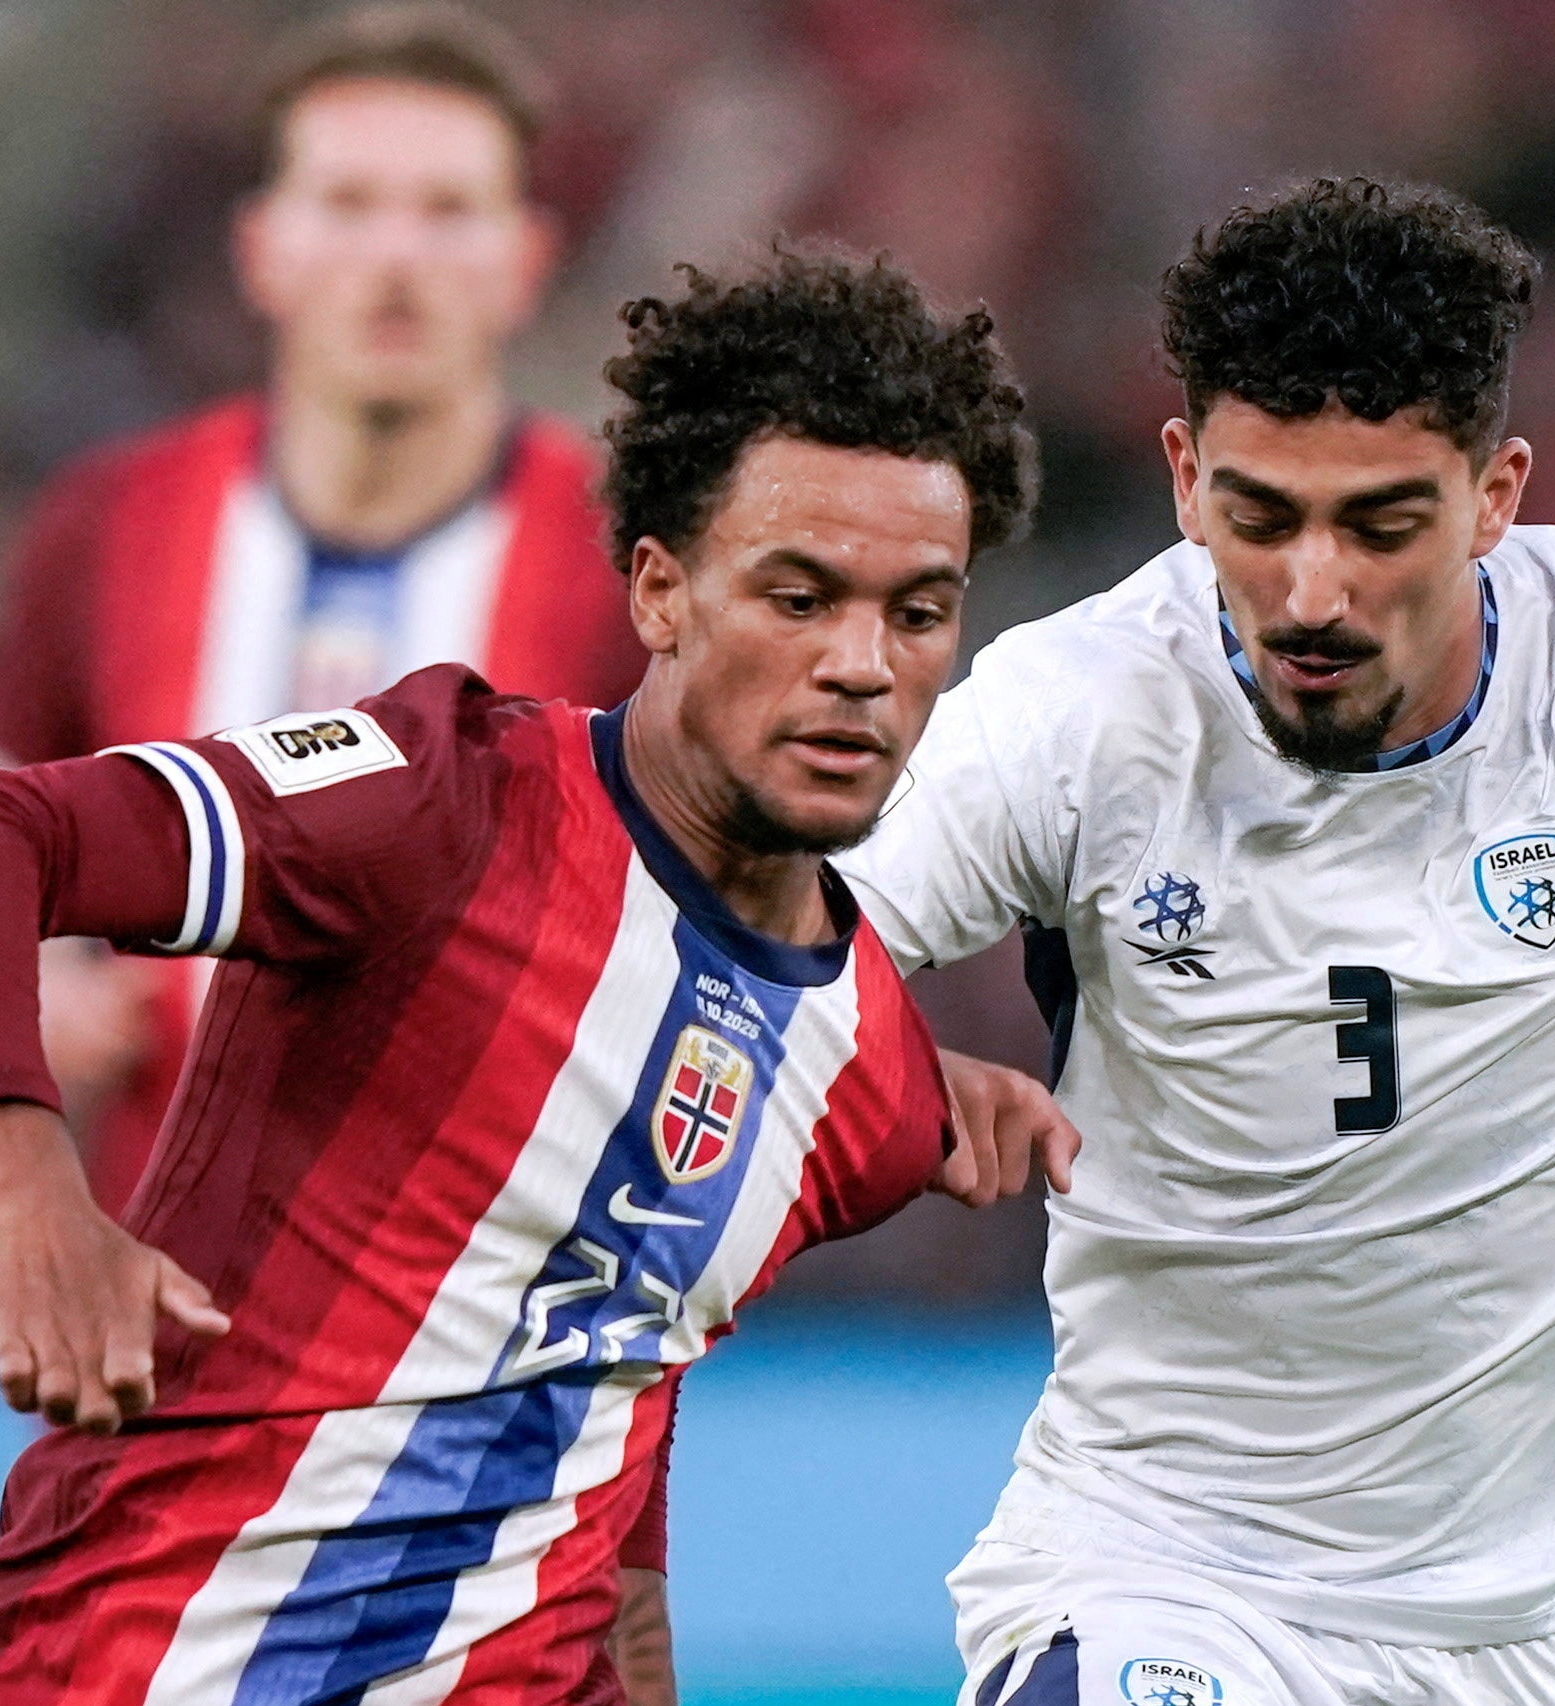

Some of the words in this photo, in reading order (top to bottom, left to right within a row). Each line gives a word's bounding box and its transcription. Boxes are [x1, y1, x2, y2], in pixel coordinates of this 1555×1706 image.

[695, 973, 730, 1001] NOR
[1328, 966, 1402, 1136] 3
[496, 1237, 682, 1387] 22
[1141, 1663, 1207, 1686] ISRAEL
